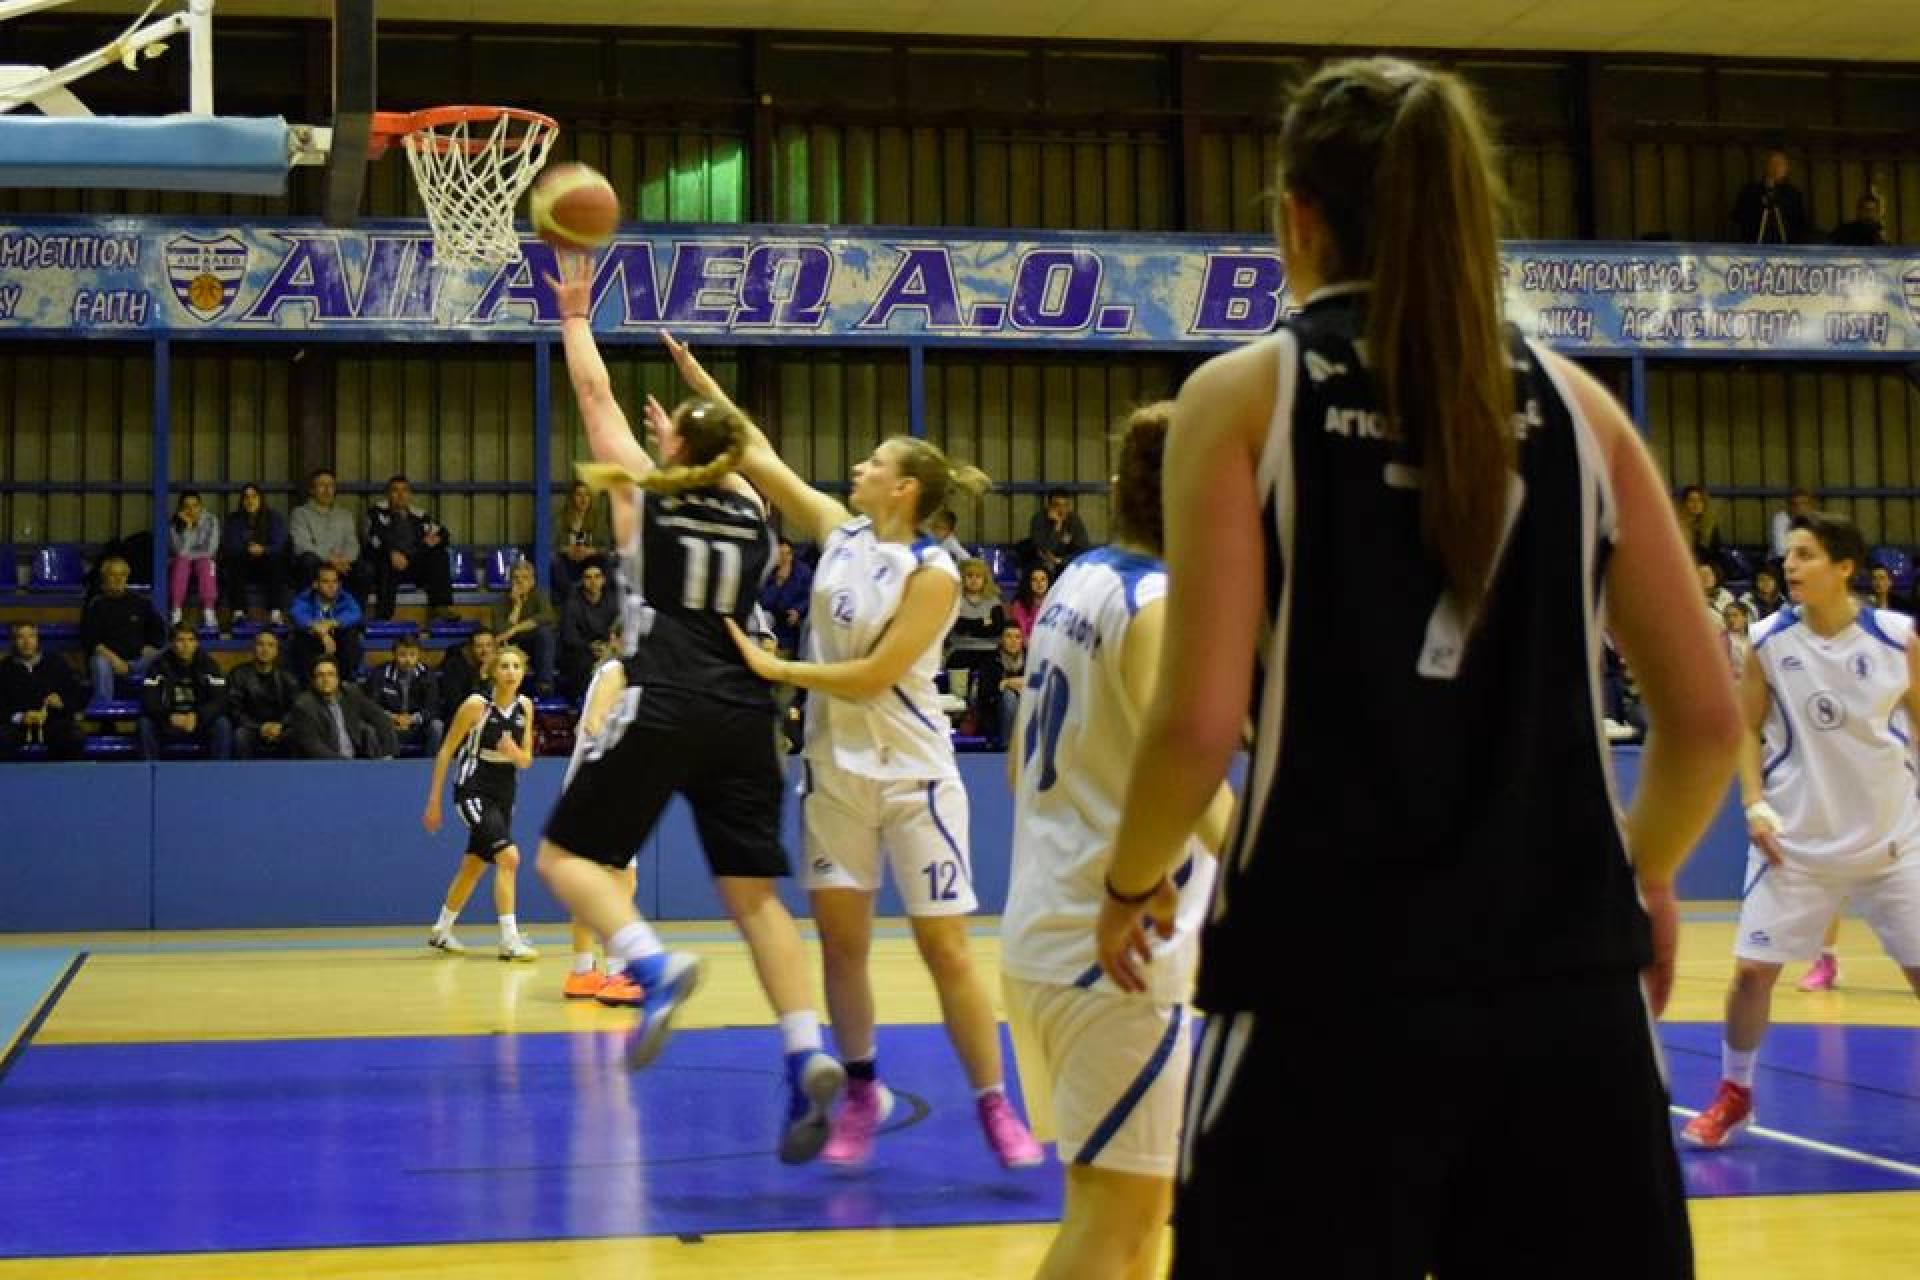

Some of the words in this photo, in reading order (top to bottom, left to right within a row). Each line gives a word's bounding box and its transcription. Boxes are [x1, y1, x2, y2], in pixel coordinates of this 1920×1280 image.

[0, 286, 20, 317] Y
[74, 289, 148, 323] FAITH
[1186, 250, 1300, 336] Β
[679, 535, 742, 615] 11
[922, 861, 958, 900] 12
